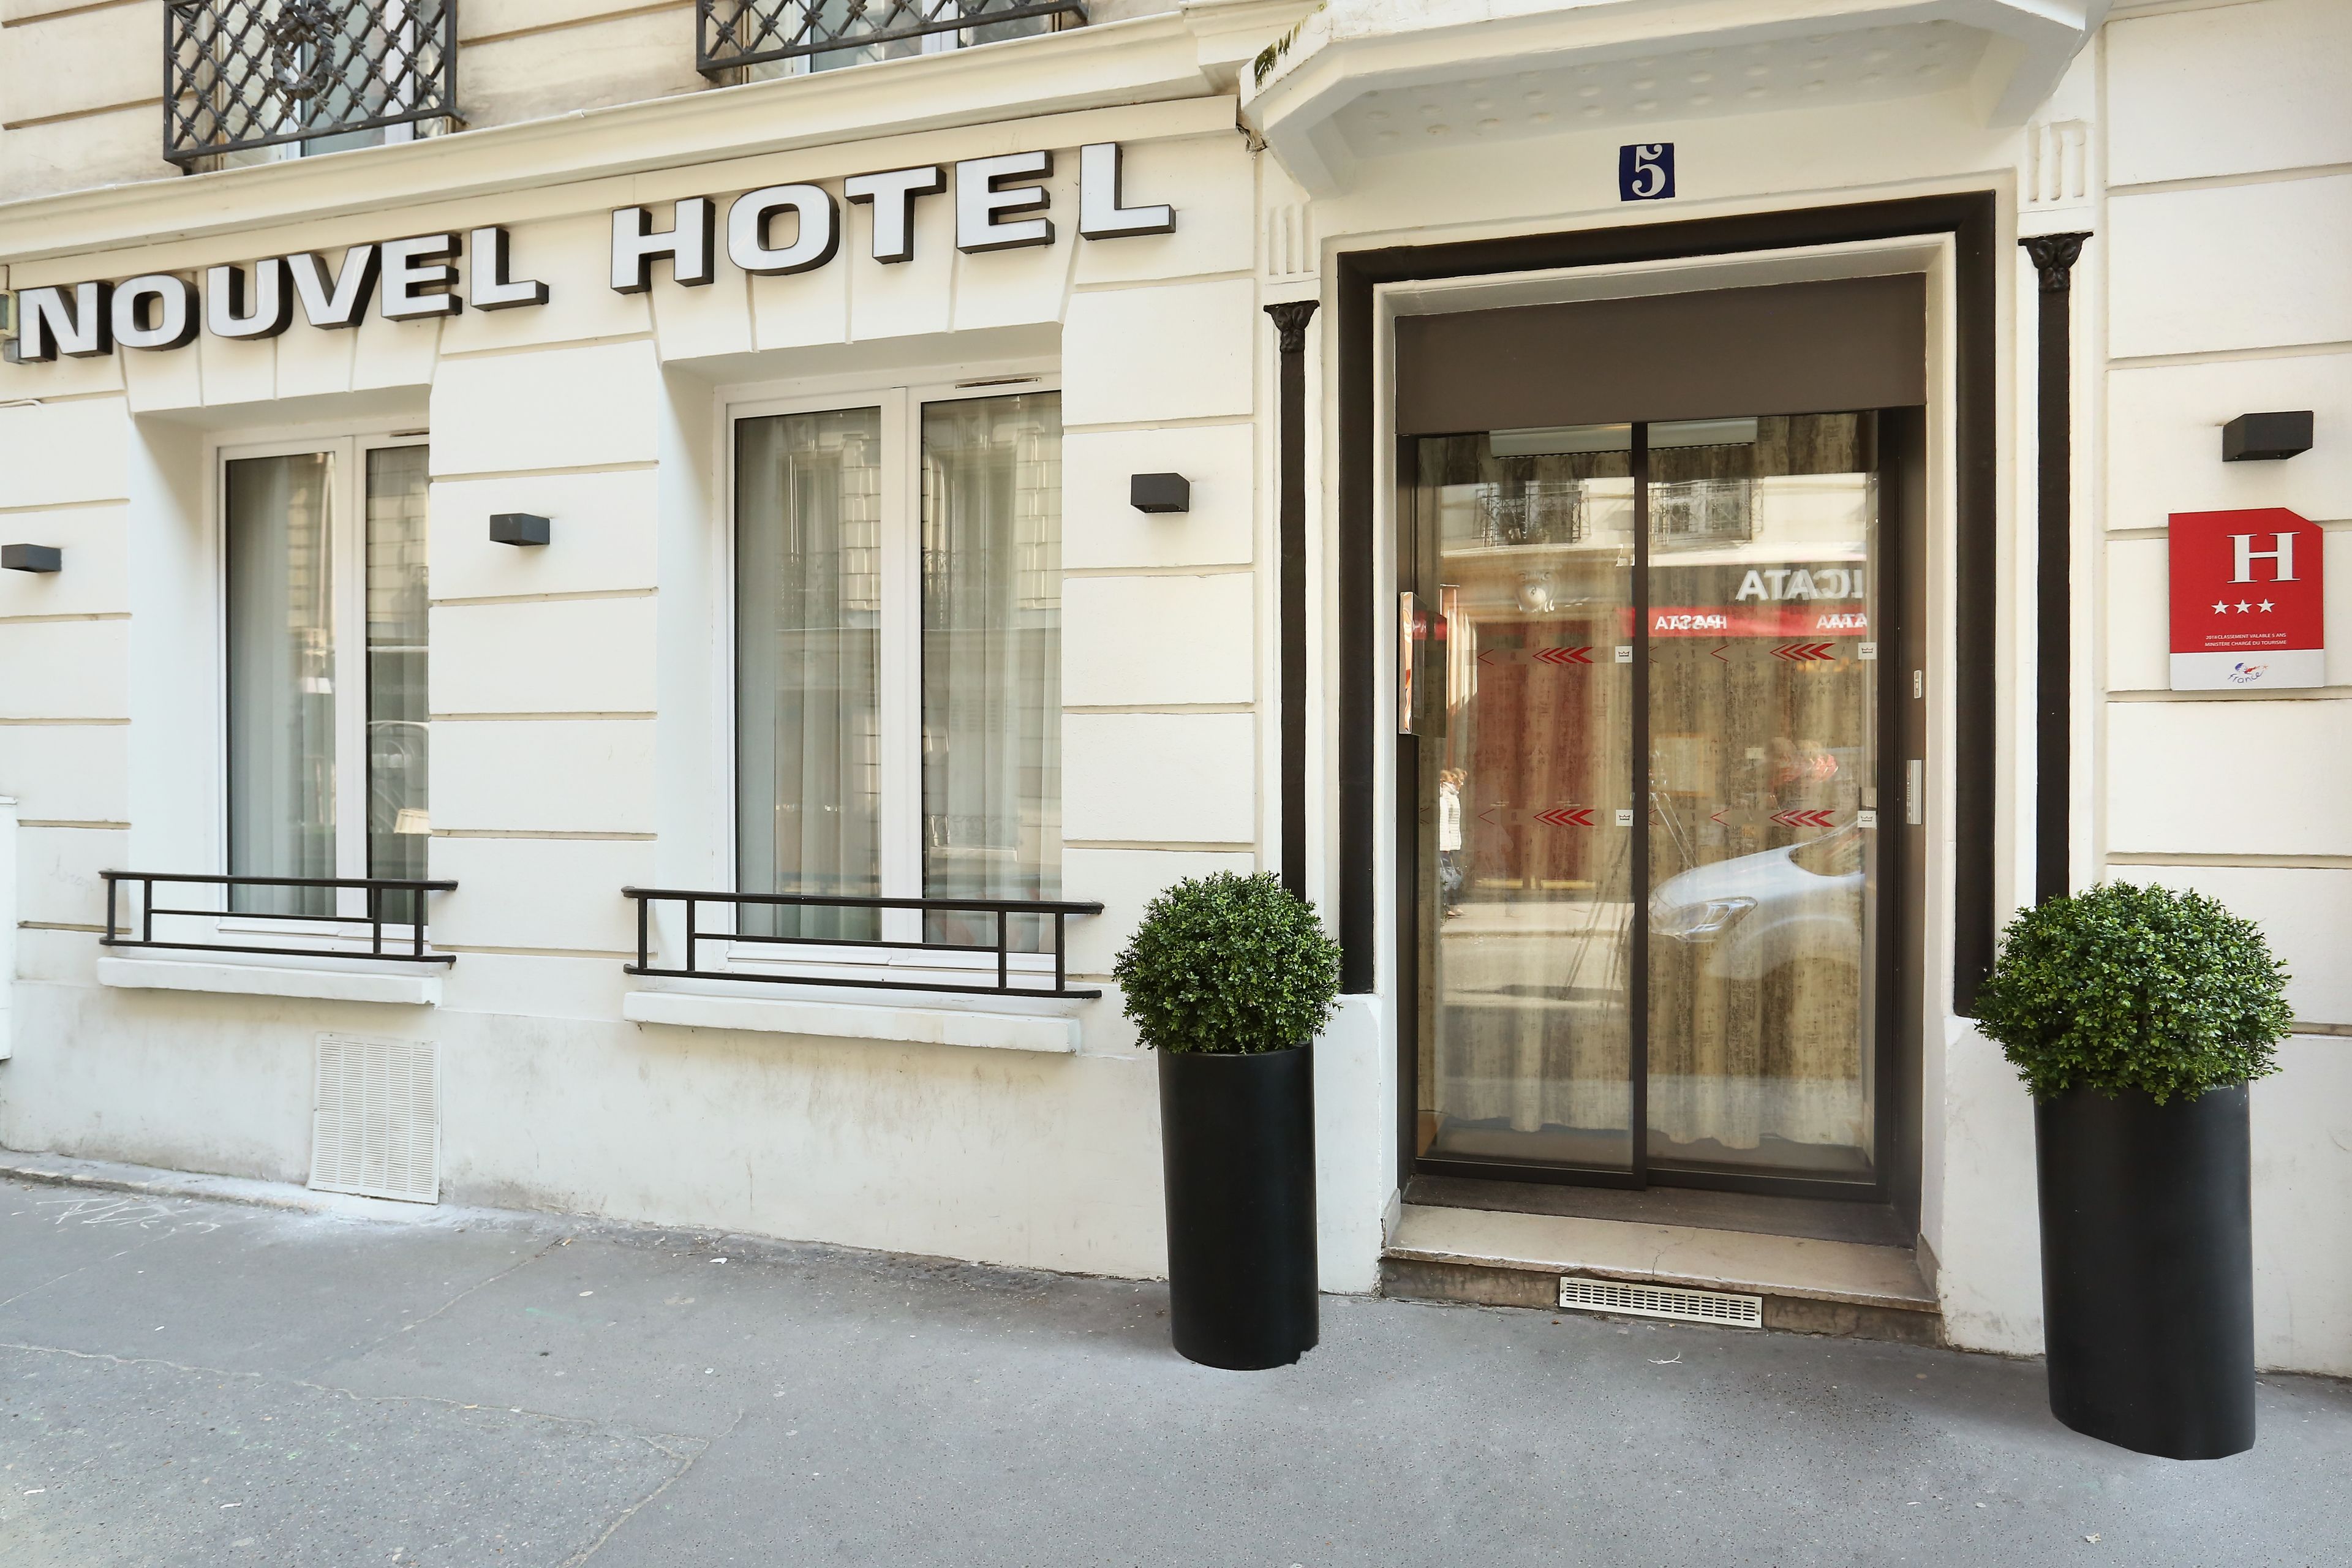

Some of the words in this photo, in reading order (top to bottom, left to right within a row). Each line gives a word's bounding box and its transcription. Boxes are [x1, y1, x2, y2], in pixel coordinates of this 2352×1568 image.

[1632, 144, 1665, 197] 5
[19, 227, 549, 363] NOUVEL
[611, 141, 1176, 295] HOTEL
[2226, 531, 2301, 583] H
